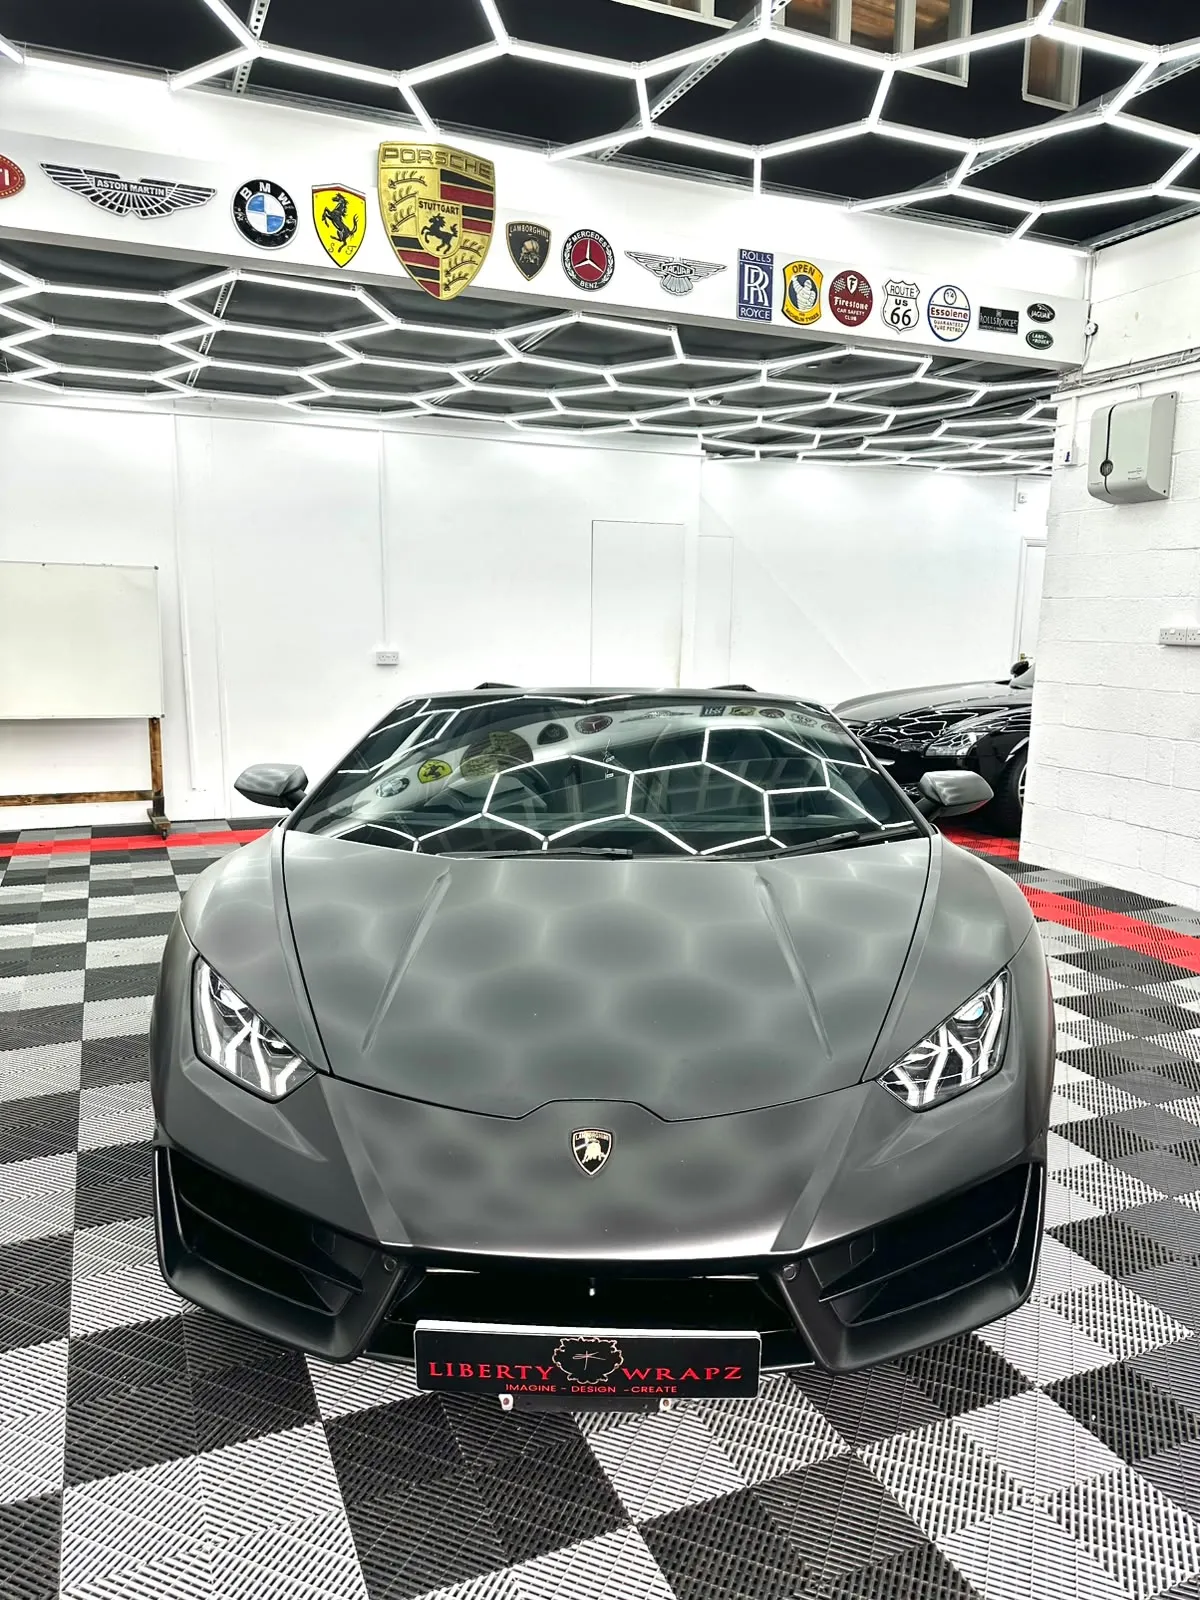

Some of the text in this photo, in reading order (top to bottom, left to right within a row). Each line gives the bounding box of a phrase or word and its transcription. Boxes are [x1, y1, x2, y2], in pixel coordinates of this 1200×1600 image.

[382, 147, 492, 180] PORSCHE
[97, 179, 165, 196] ASTON MARTIN
[240, 182, 291, 206] BMW
[418, 200, 459, 216] STUTTGART
[509, 224, 549, 238] LAMBORGHINI
[571, 230, 608, 249] MERCEDES
[741, 250, 772, 263] ROLLS
[662, 264, 691, 275] JAGUAR
[792, 263, 816, 276] OPEN
[579, 280, 598, 289] BENZ
[890, 285, 915, 298] ROUTE
[833, 296, 869, 310] Firestone
[894, 298, 909, 307] US
[740, 308, 771, 320] ROYCE
[785, 308, 820, 322] MICHELIN TYRES
[848, 309, 865, 317] SAFETY
[890, 307, 912, 326] 66
[931, 307, 968, 319] Essolene
[428, 1362, 742, 1381] LIBERTY WRAPZ
[505, 1383, 557, 1393] IMAGINE
[571, 1385, 616, 1393] DESIGN
